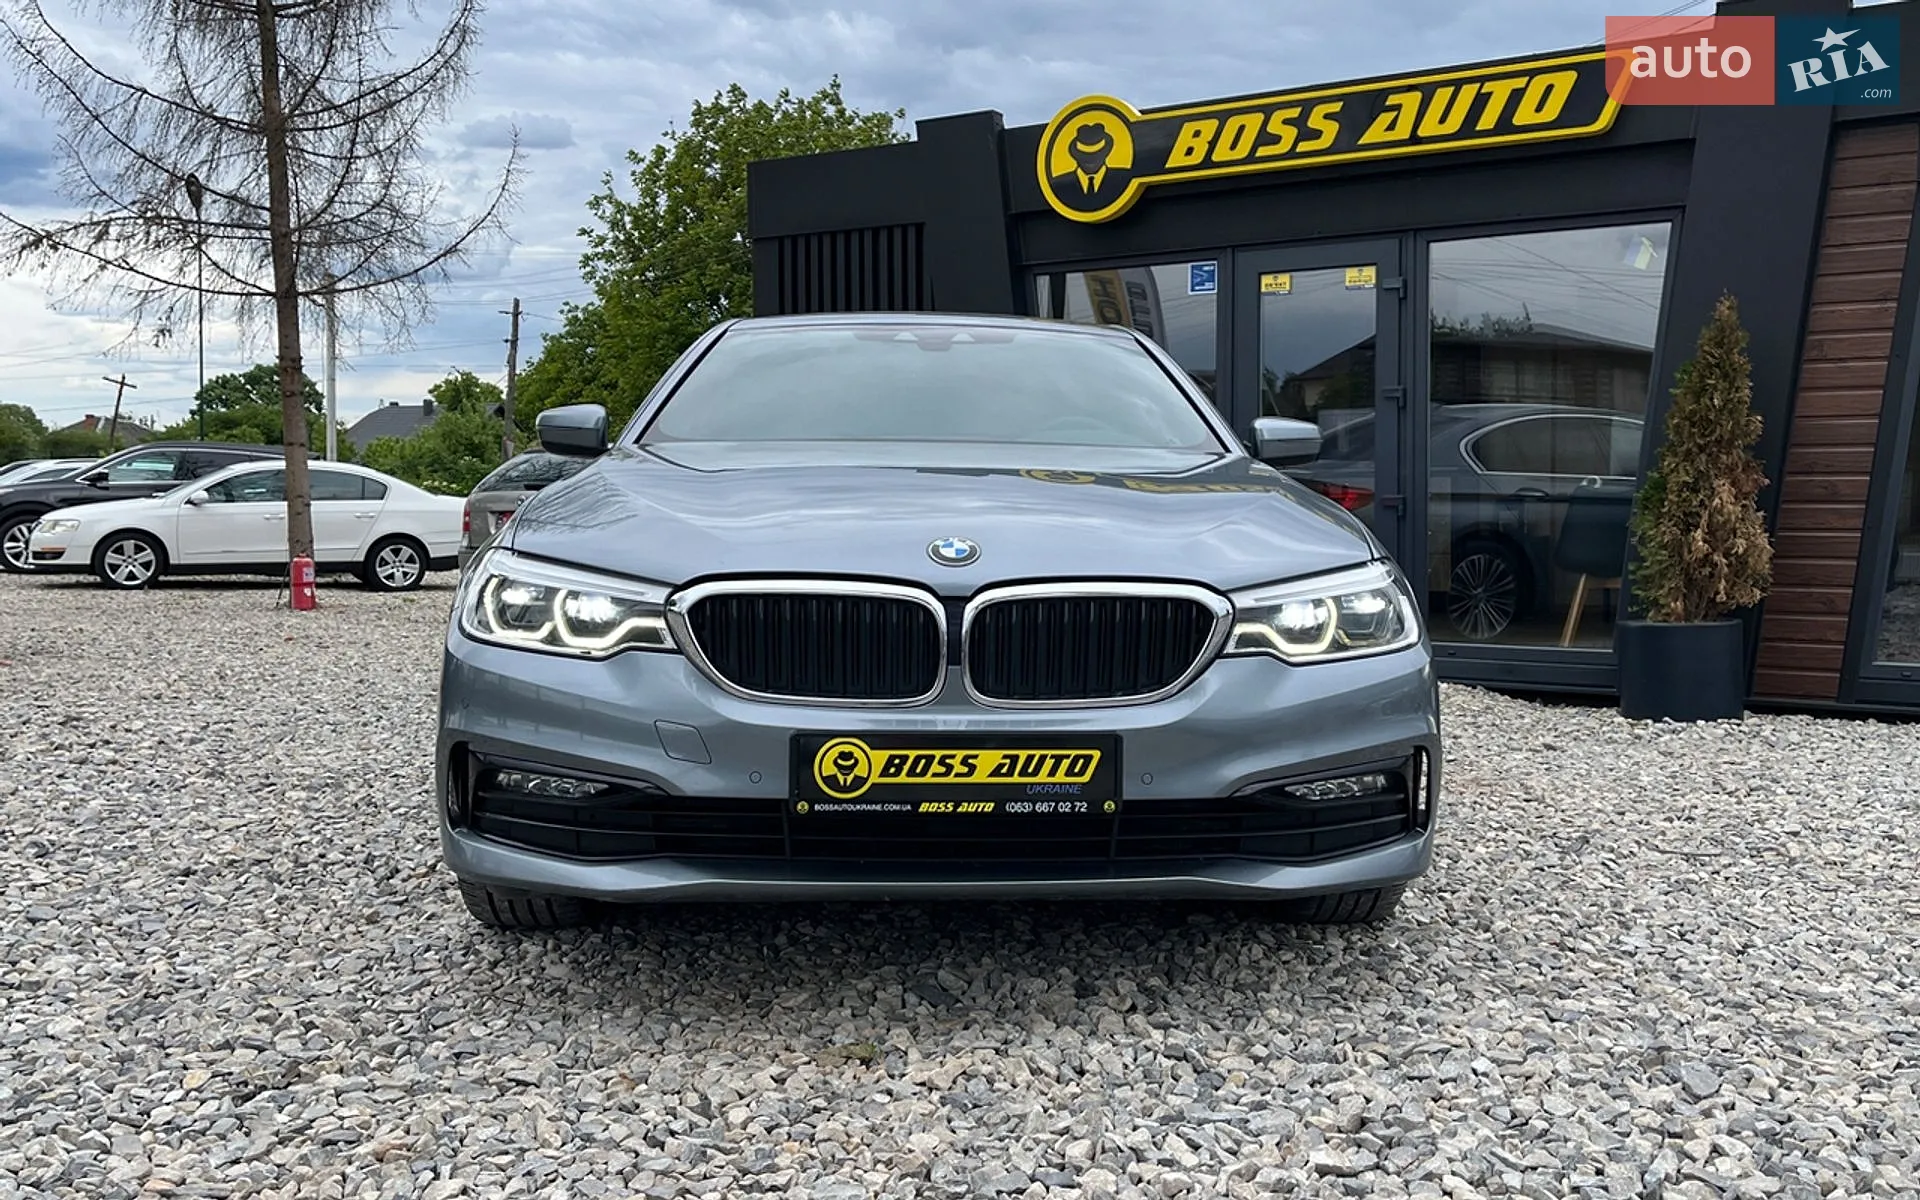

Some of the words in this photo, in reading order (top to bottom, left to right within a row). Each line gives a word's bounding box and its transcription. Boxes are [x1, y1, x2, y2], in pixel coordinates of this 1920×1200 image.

[1165, 101, 1344, 169] BOSS
[1357, 69, 1578, 145] AUTO
[877, 753, 980, 779] BOSS
[985, 753, 1095, 779] AUTO
[1026, 784, 1082, 794] UKRAINE
[918, 802, 954, 813] BOSS
[956, 802, 996, 813] AUTO
[1005, 801, 1033, 813] (063)
[1035, 802, 1056, 813] 667
[1057, 802, 1072, 812] 02
[1074, 802, 1088, 812] 72
